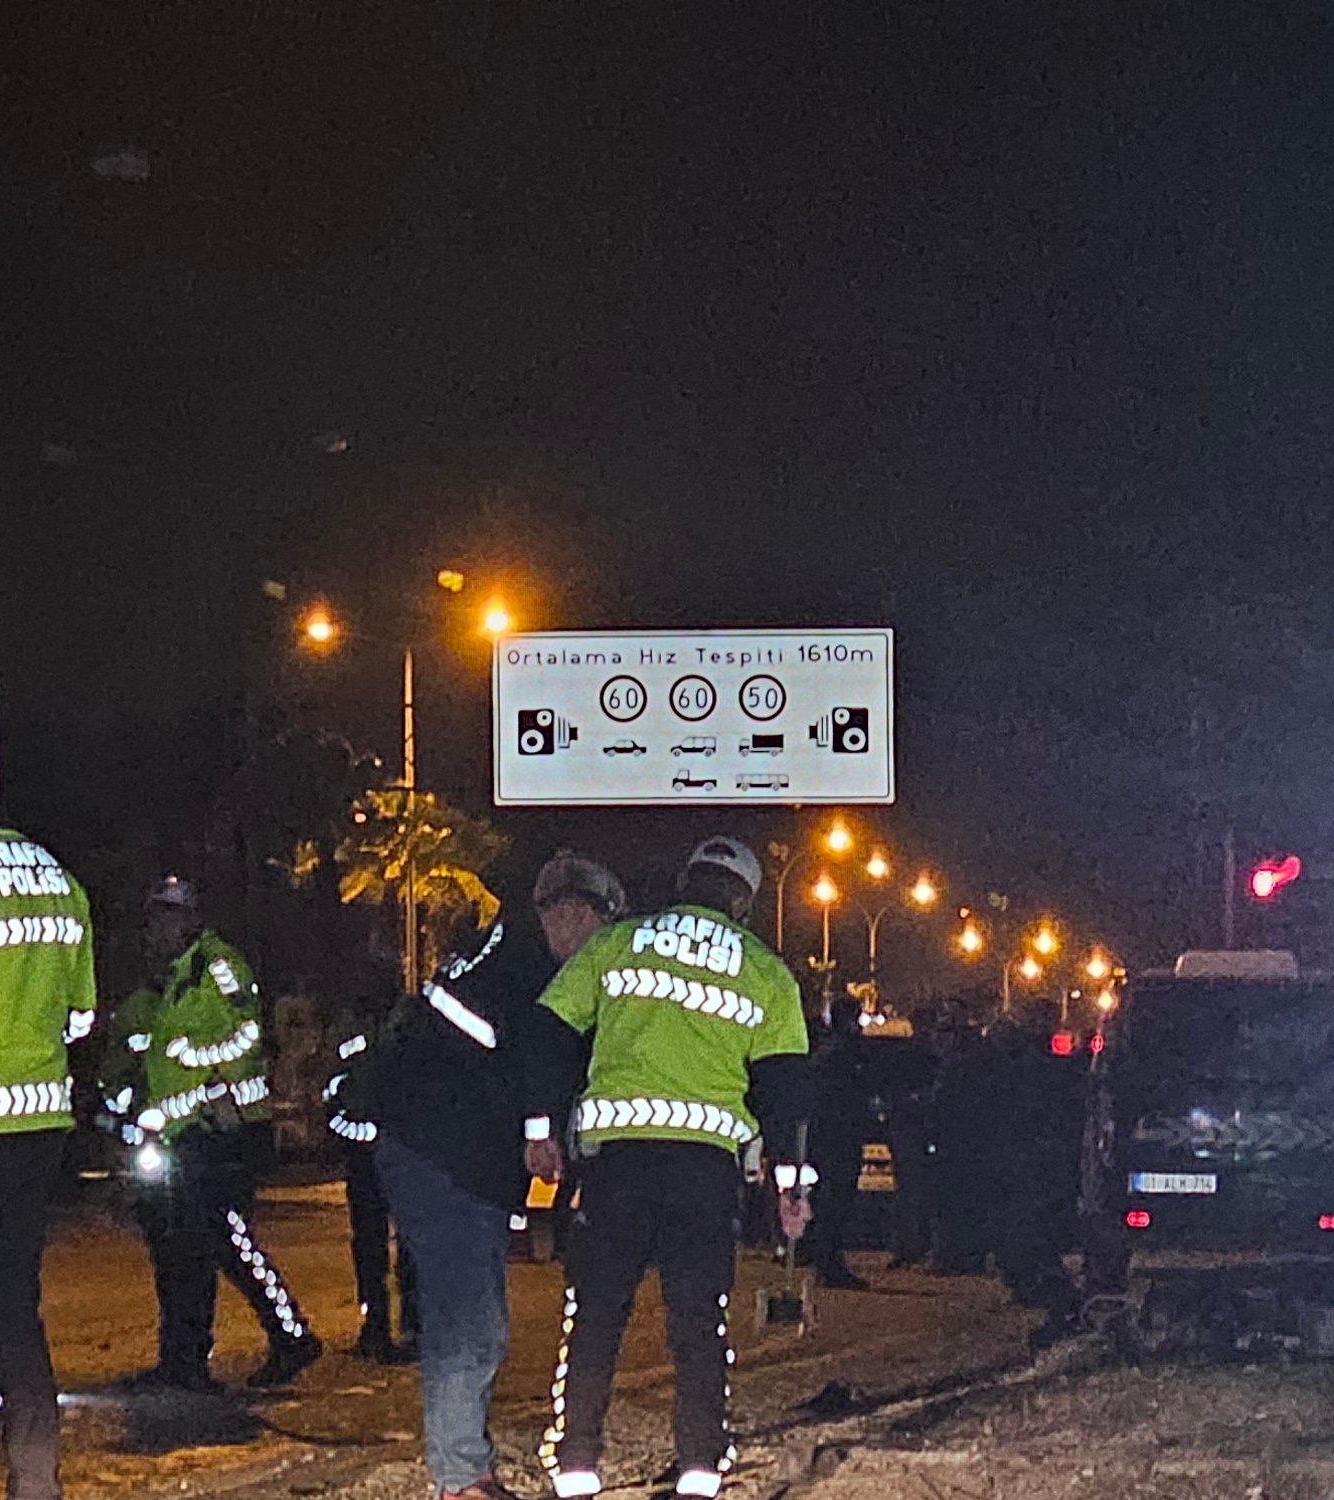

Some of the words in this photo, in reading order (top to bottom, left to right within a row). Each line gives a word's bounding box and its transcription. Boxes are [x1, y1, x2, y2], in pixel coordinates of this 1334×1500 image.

[507, 648, 622, 665] Ortalama
[639, 648, 677, 665] Hız
[695, 646, 783, 668] Tespiti
[798, 644, 874, 663] 1610m
[608, 687, 639, 710] 60
[678, 687, 708, 709] 60
[749, 686, 778, 709] 50
